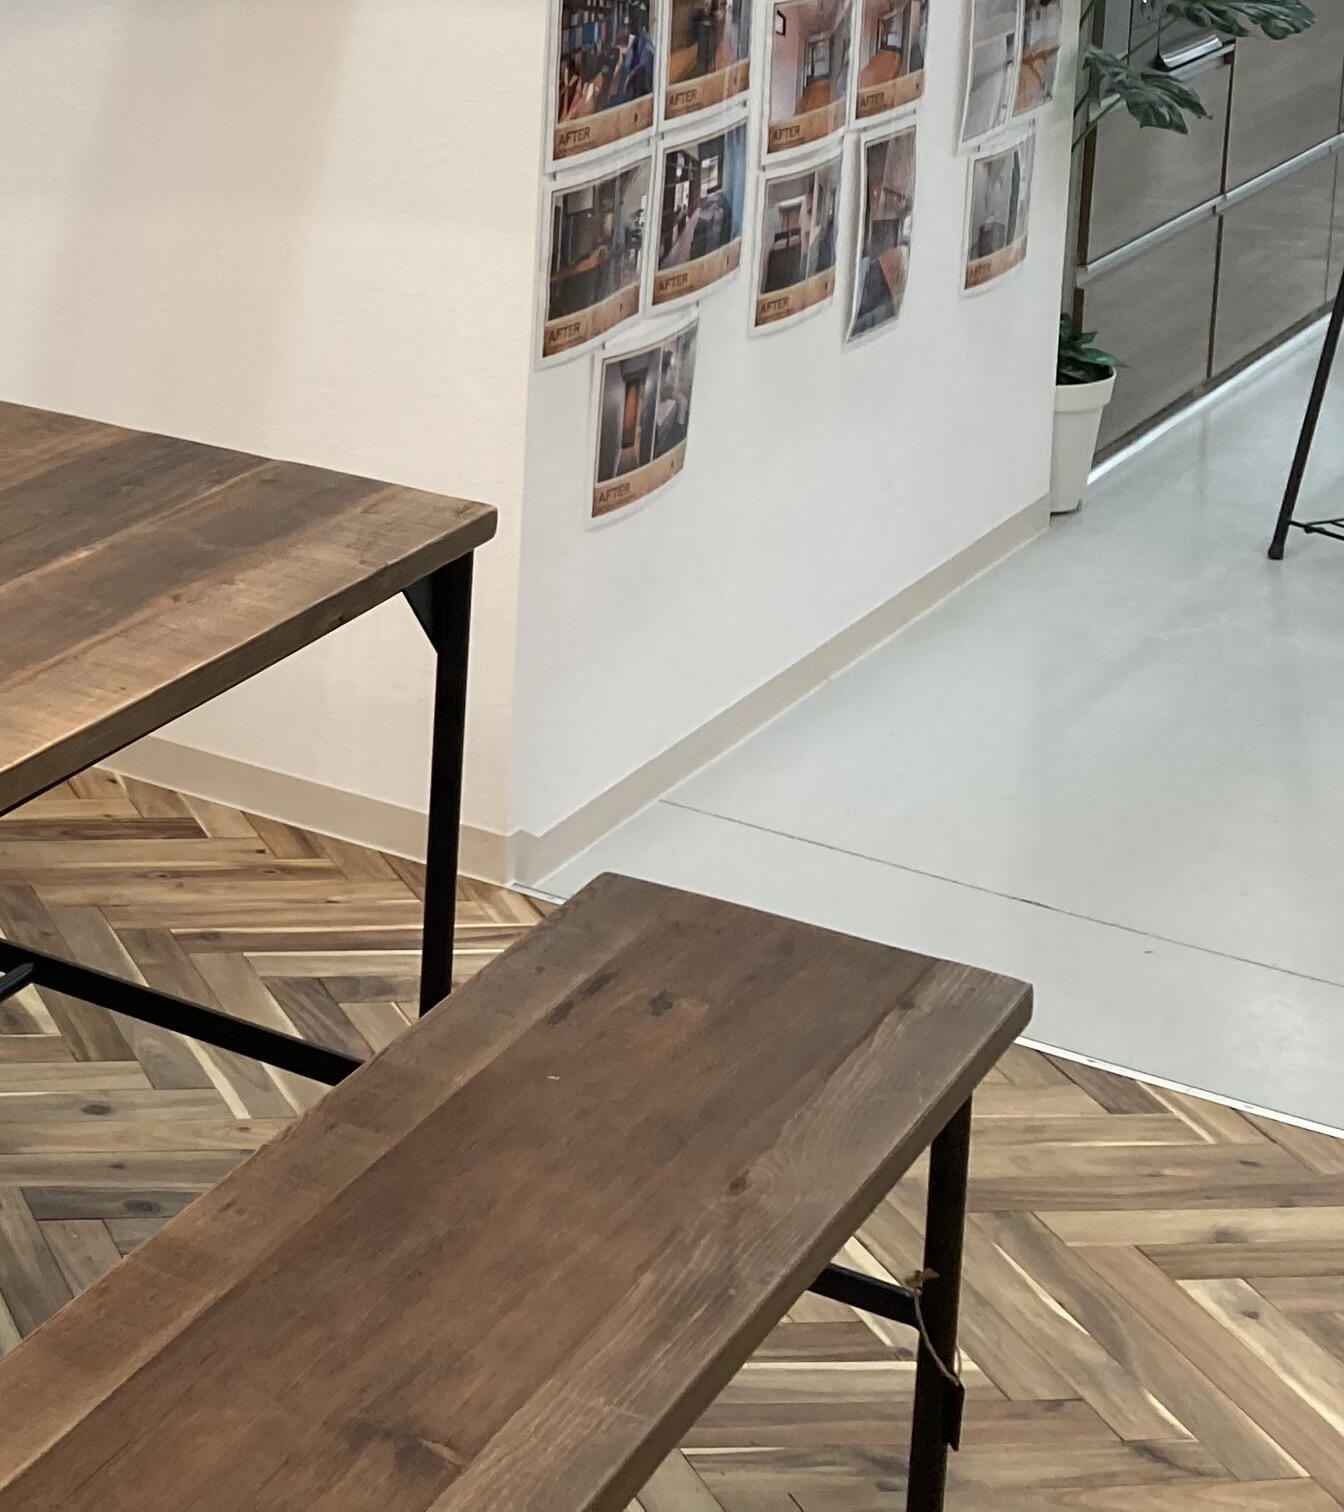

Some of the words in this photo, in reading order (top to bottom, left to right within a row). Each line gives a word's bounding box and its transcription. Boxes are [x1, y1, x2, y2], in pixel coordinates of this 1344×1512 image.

[669, 89, 697, 106] AFTER
[558, 126, 591, 147] AFTER
[772, 125, 801, 141] AFTER
[658, 272, 688, 291] AFTER
[760, 296, 790, 313] AFTER
[549, 322, 581, 343] AFTER
[598, 482, 631, 503] AFTER
